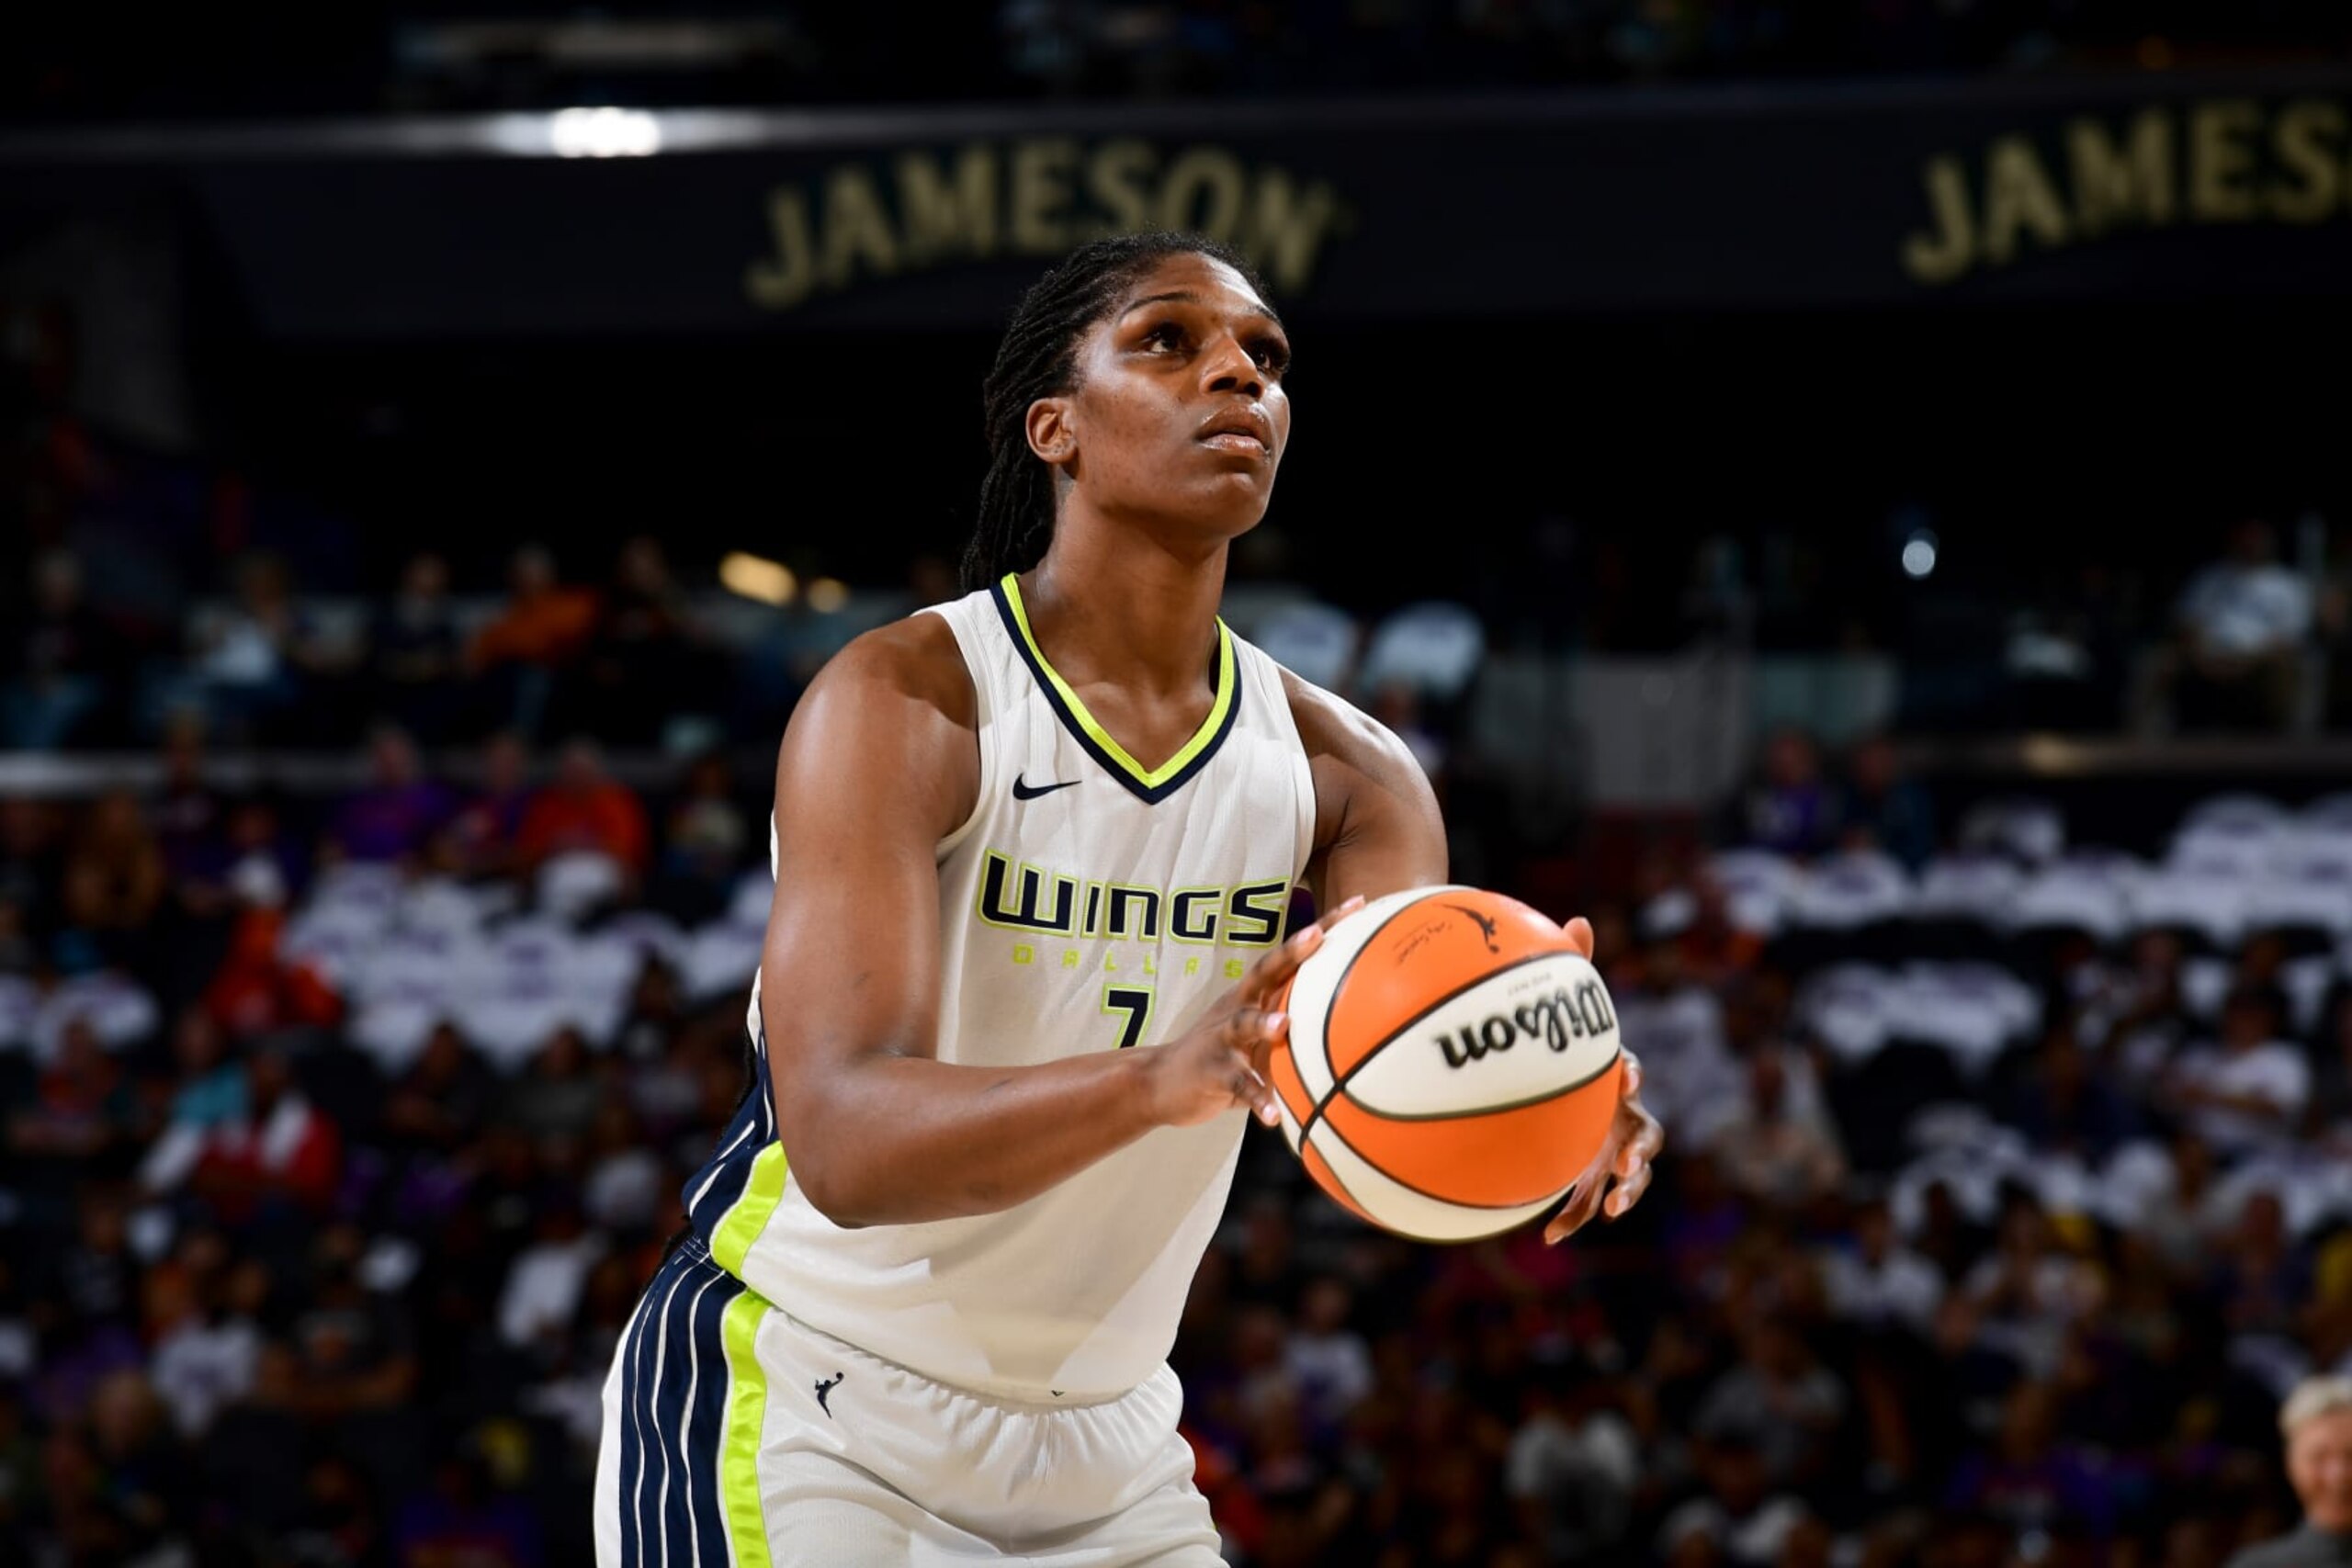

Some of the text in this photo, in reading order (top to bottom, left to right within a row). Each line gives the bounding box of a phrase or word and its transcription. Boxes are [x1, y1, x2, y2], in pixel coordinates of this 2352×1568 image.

[742, 137, 1335, 310] JAMESON
[1899, 97, 2352, 287] JAMES
[978, 848, 1291, 948] WINGS
[1013, 943, 1243, 978] DALLAS
[1102, 983, 1154, 1048] 7
[1433, 977, 1614, 1068] Wilson
